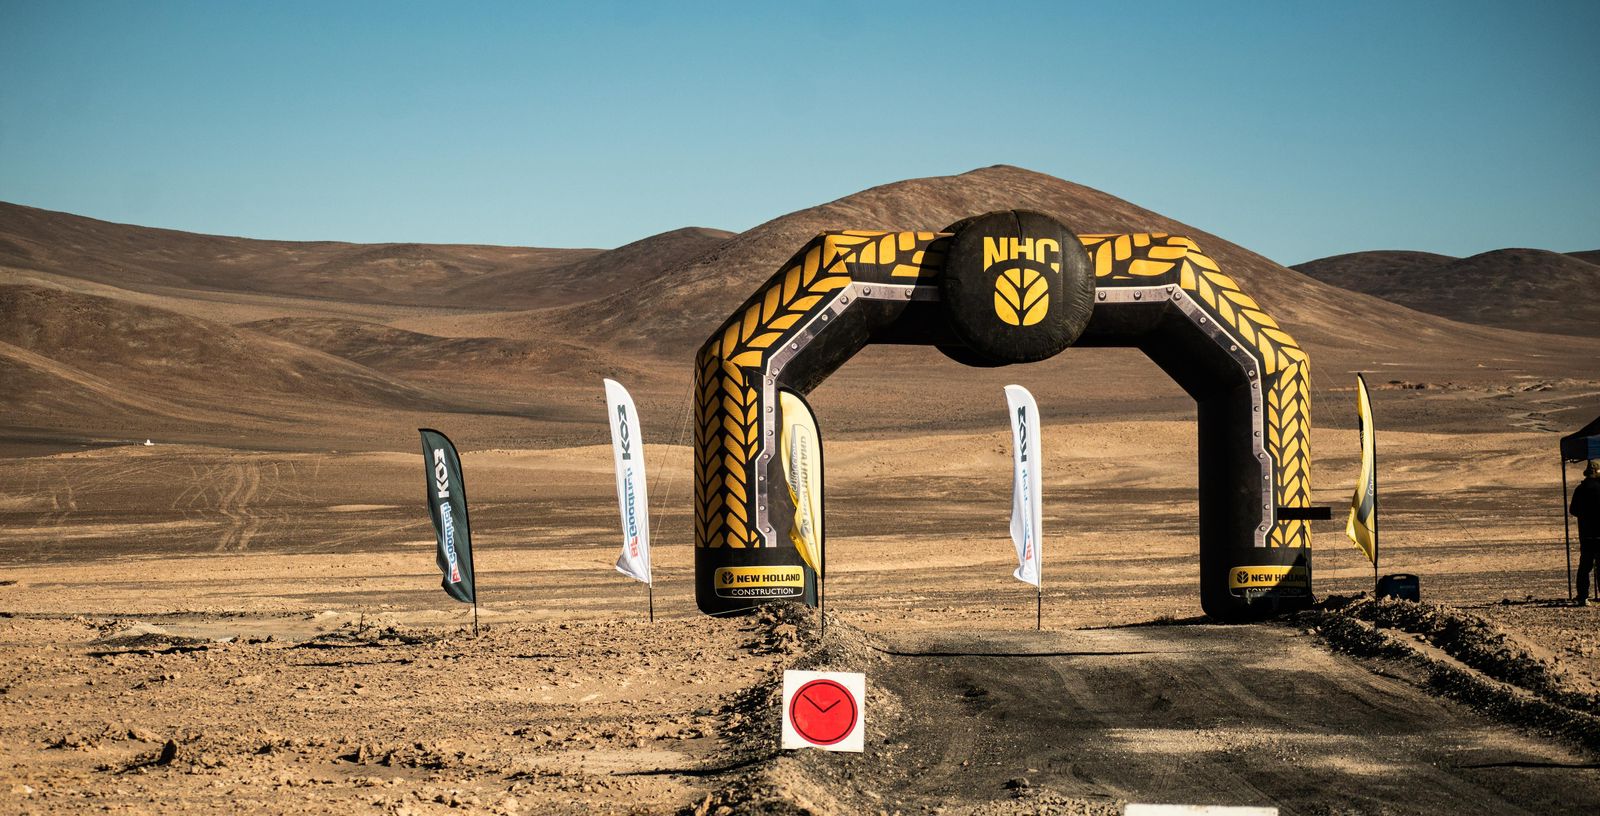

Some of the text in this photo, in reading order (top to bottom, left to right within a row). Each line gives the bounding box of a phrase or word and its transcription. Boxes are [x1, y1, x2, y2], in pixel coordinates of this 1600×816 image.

[984, 236, 1059, 273] NHC
[737, 573, 800, 583] NEW HOLLAND
[1251, 574, 1273, 582] NEW
[731, 587, 794, 596] CONSTRUCTION
